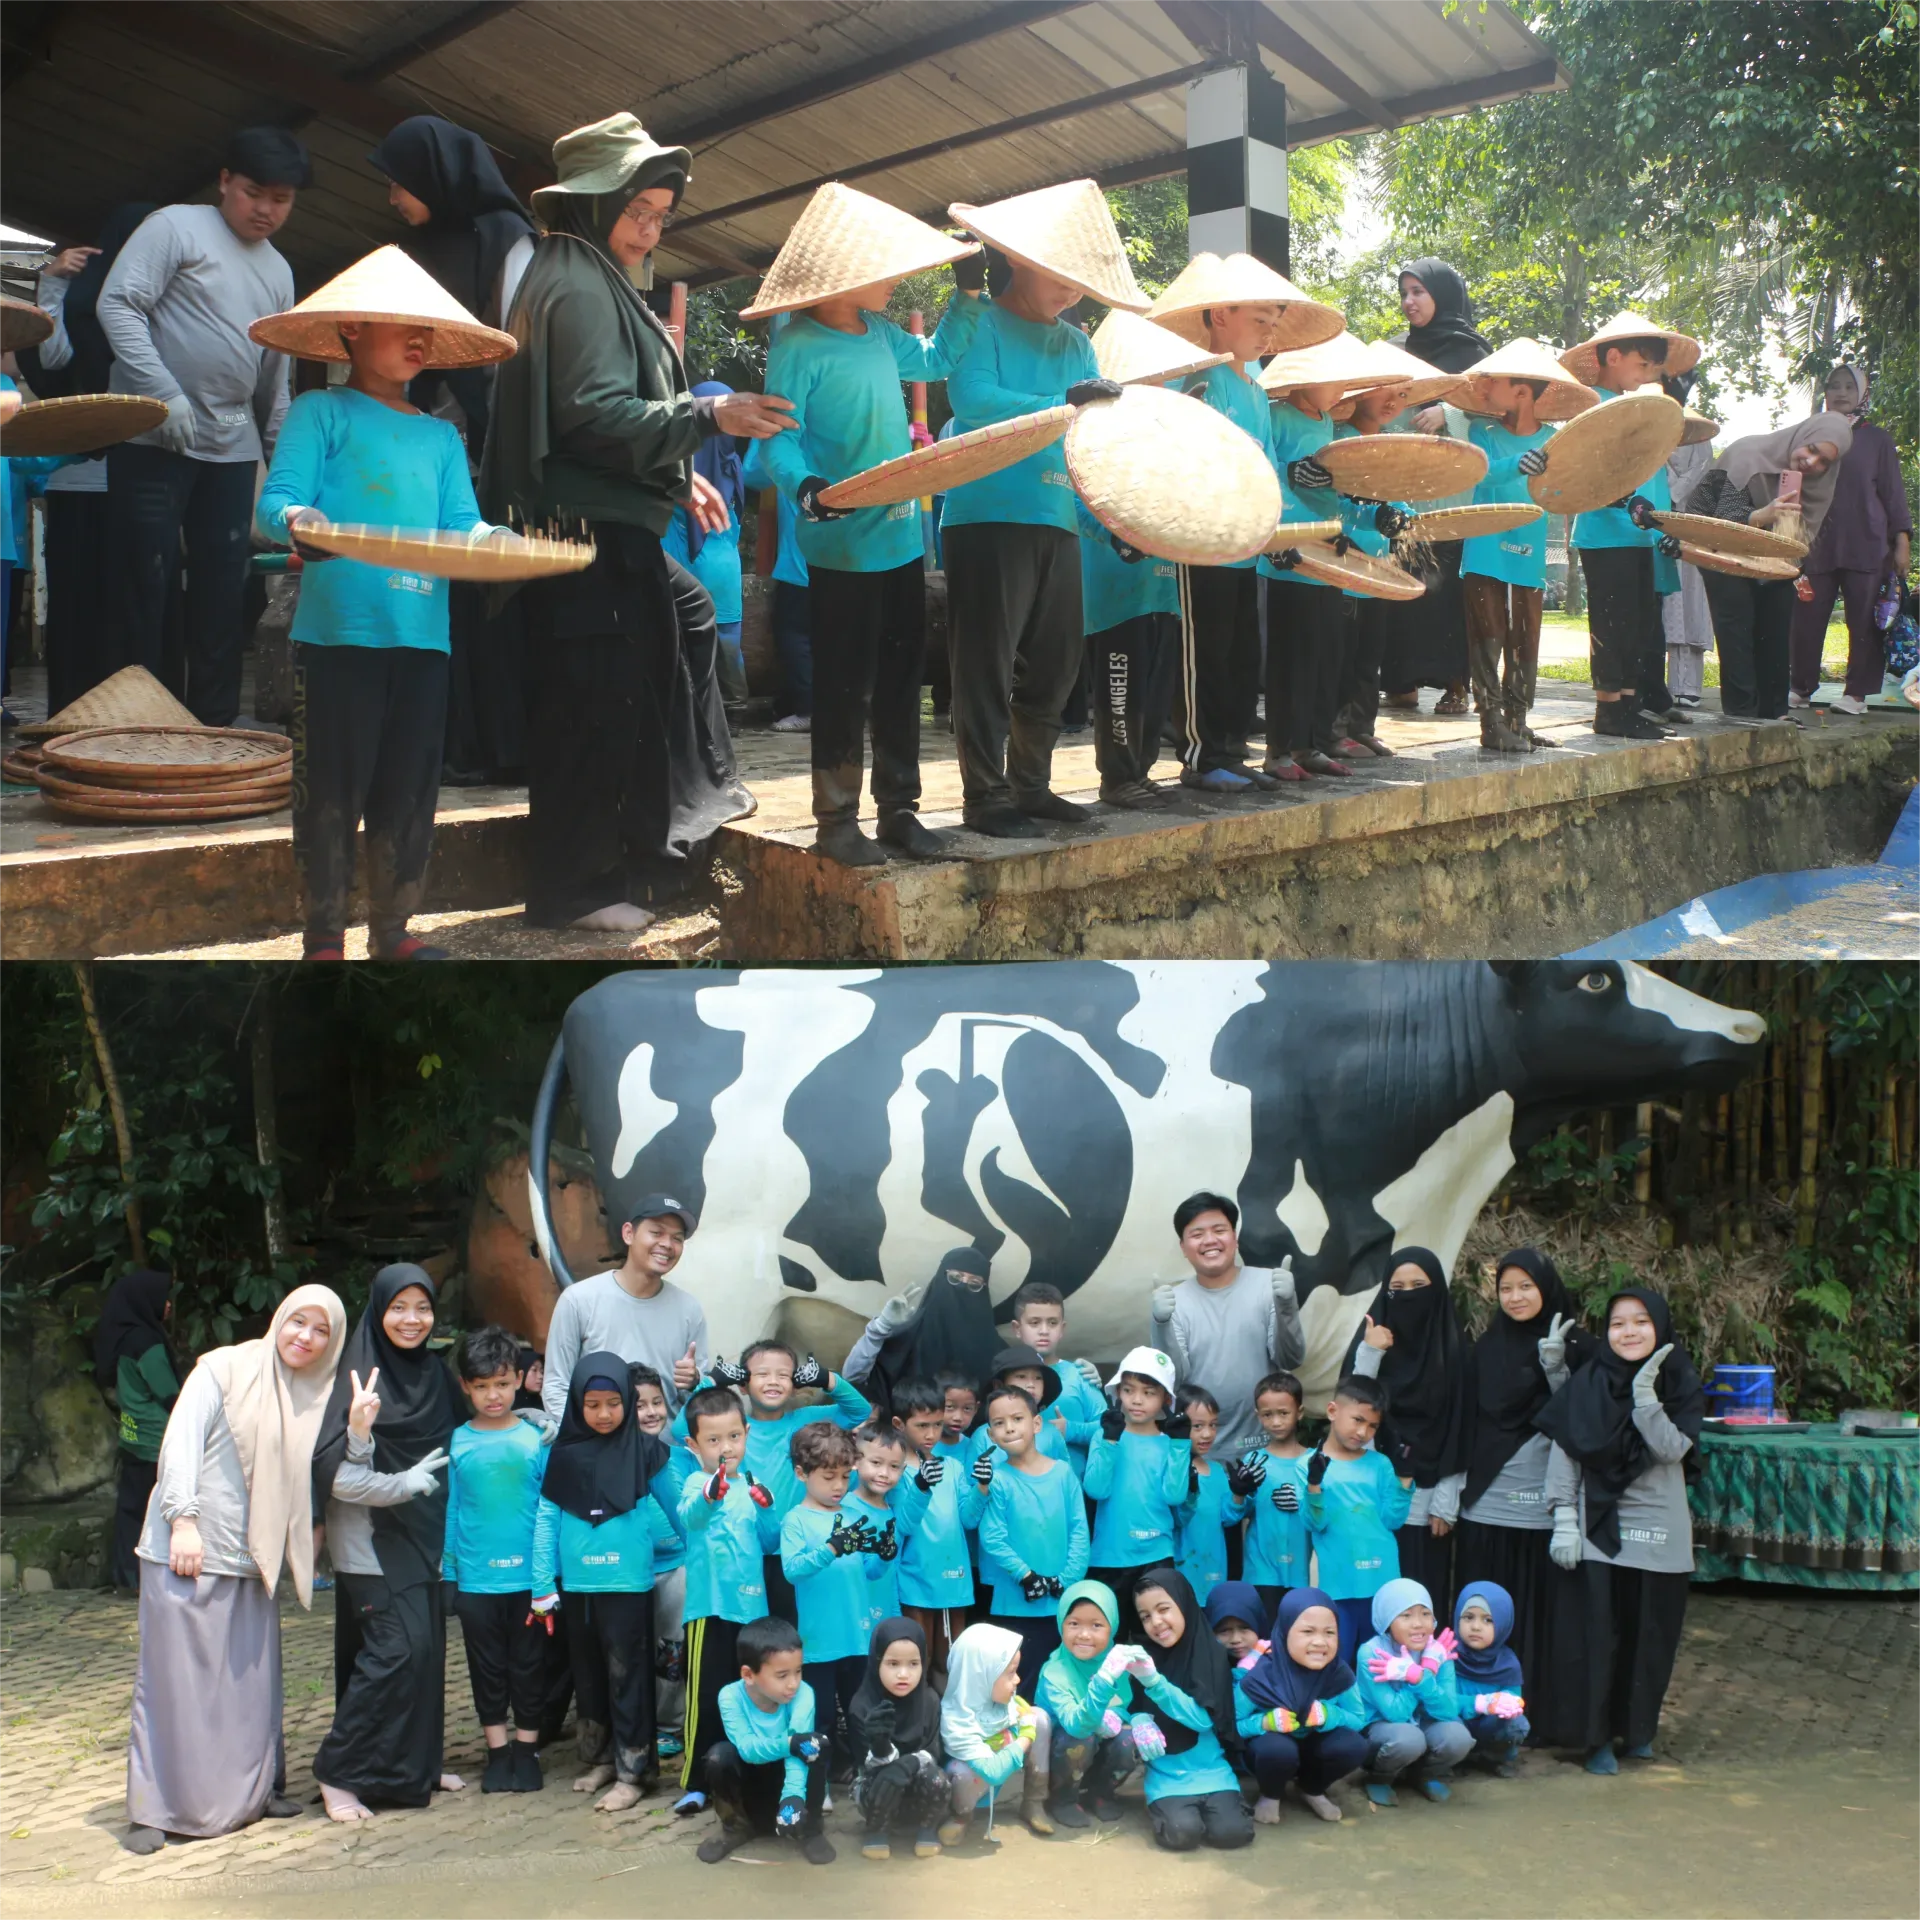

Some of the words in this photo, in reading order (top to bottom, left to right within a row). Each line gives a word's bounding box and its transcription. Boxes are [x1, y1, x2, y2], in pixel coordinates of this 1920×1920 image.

[1109, 652, 1129, 716] ANGELES
[1111, 719, 1128, 747] LOS
[1629, 1529, 1651, 1540] FIELD
